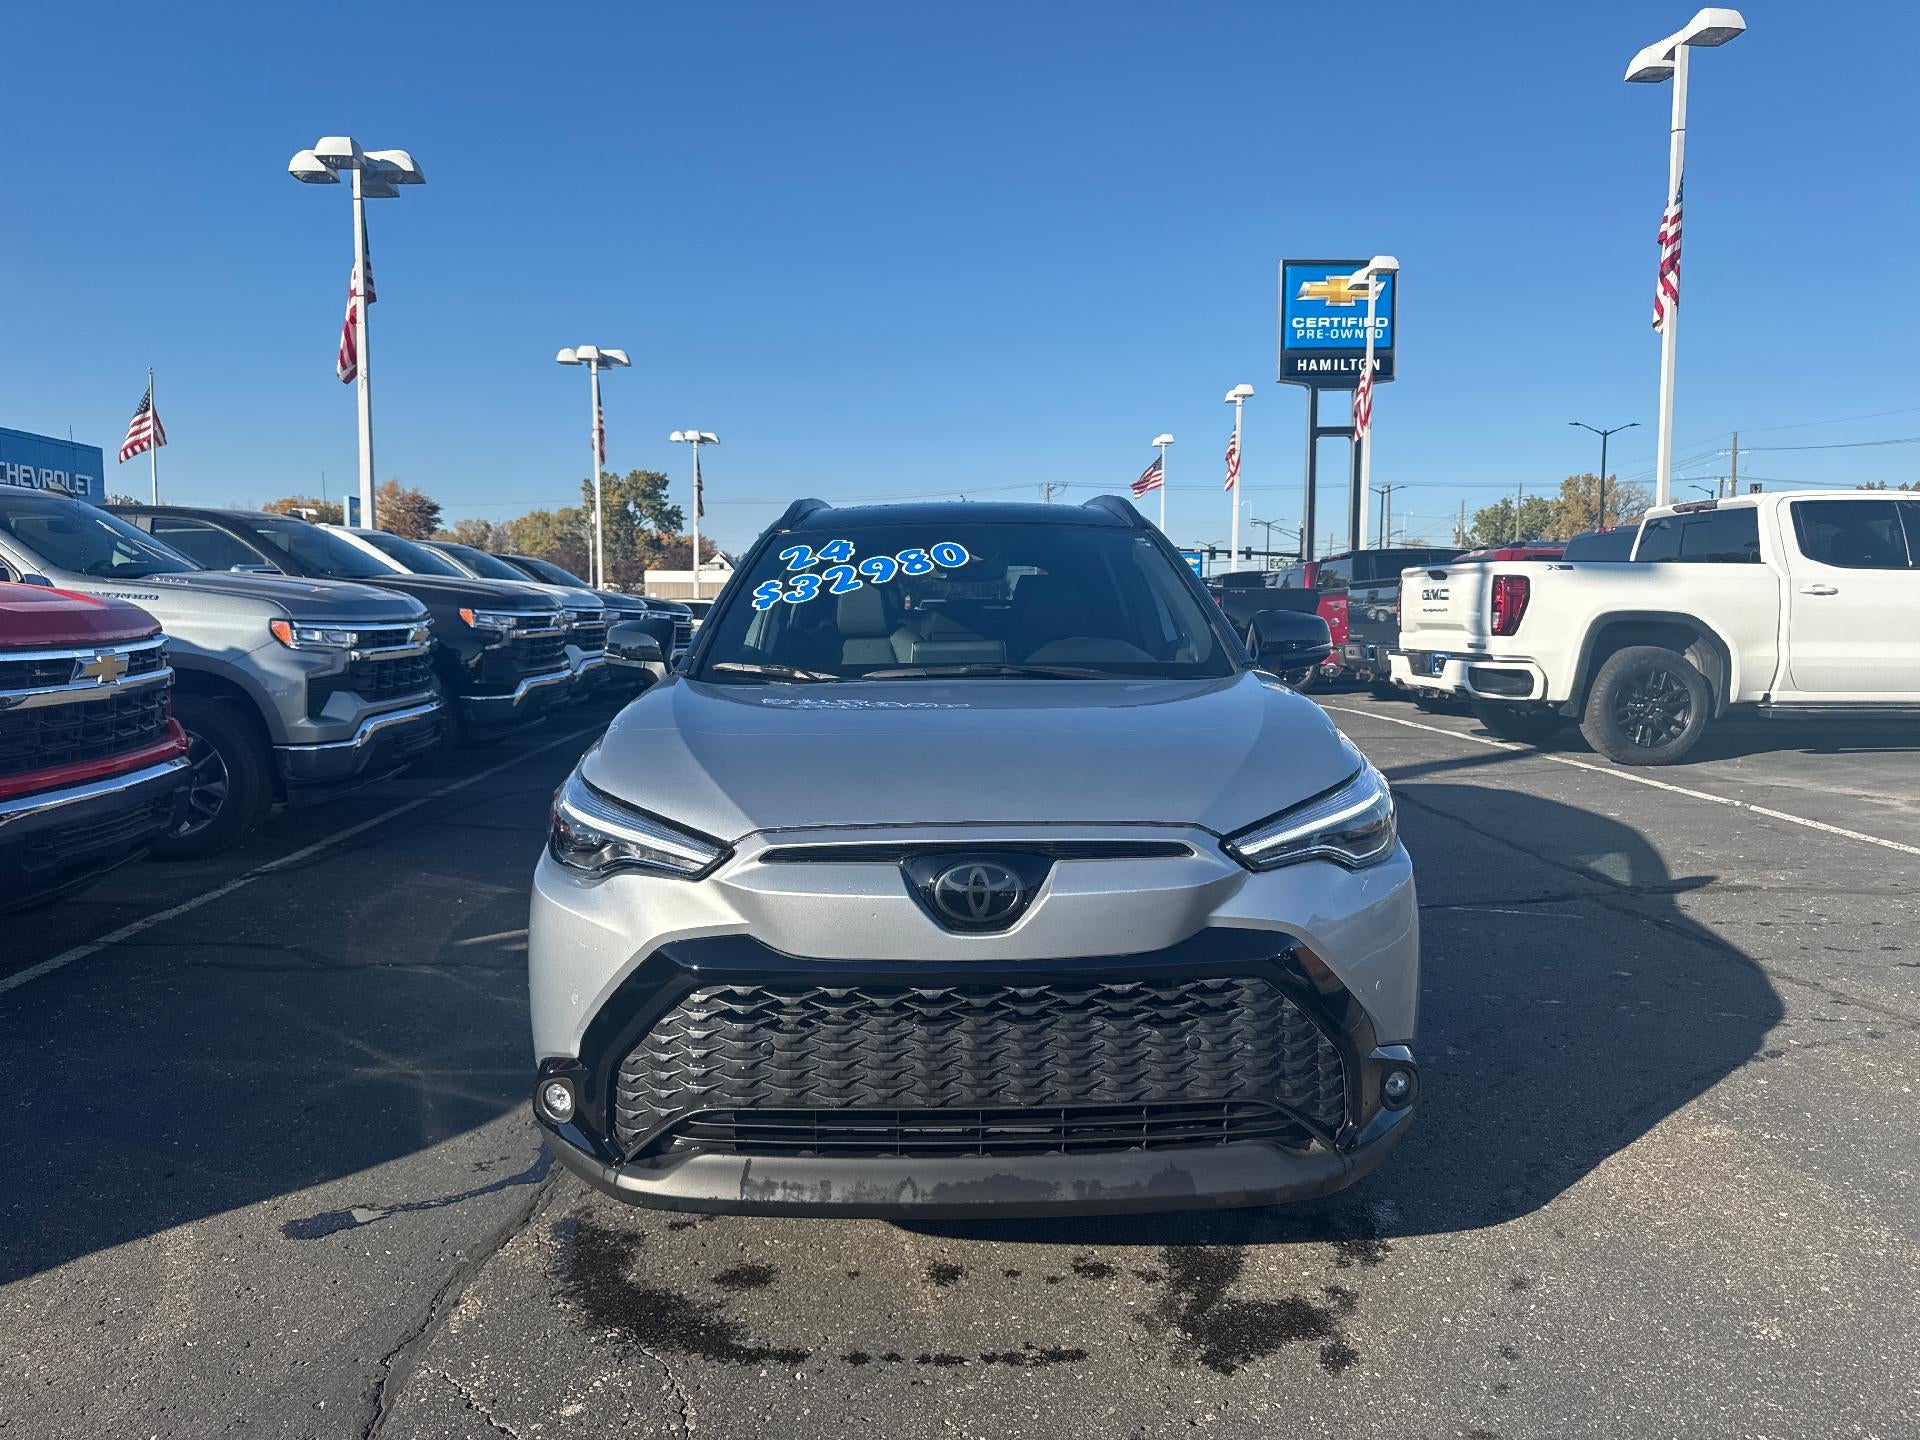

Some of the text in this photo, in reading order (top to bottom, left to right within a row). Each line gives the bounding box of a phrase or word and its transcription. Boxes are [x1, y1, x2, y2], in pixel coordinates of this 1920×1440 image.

[1296, 329, 1383, 339] PRE-OWND
[779, 540, 855, 570] 24
[752, 542, 969, 610] $32980
[1422, 589, 1450, 600] GMC
